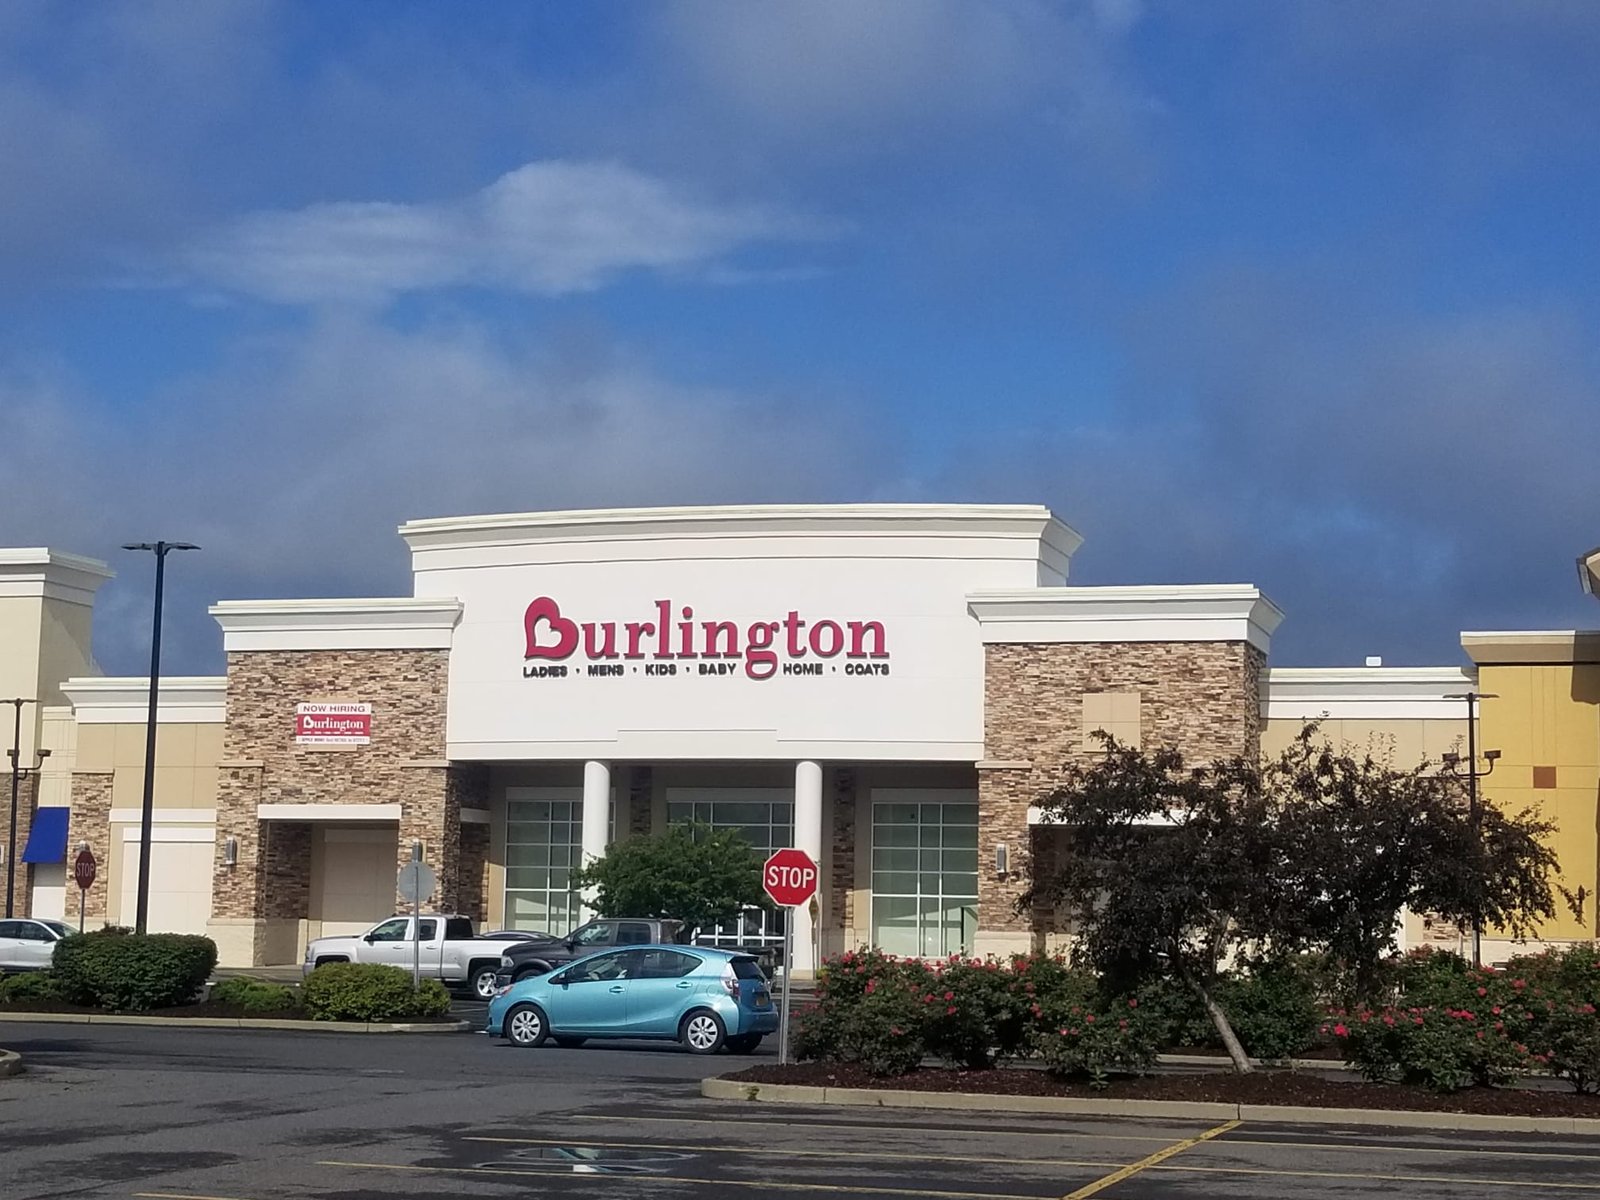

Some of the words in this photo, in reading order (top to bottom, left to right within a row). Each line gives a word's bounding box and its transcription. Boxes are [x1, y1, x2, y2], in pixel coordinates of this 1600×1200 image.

[525, 597, 890, 679] Burlington
[523, 665, 568, 678] LADIES
[588, 664, 624, 676] MENS
[645, 664, 677, 676] KIDS
[699, 663, 736, 675] BABY
[783, 663, 823, 675] HOME
[845, 663, 890, 675] COATS
[303, 715, 364, 732] Burlington
[76, 862, 95, 877] STOP
[767, 866, 815, 888] STOP
